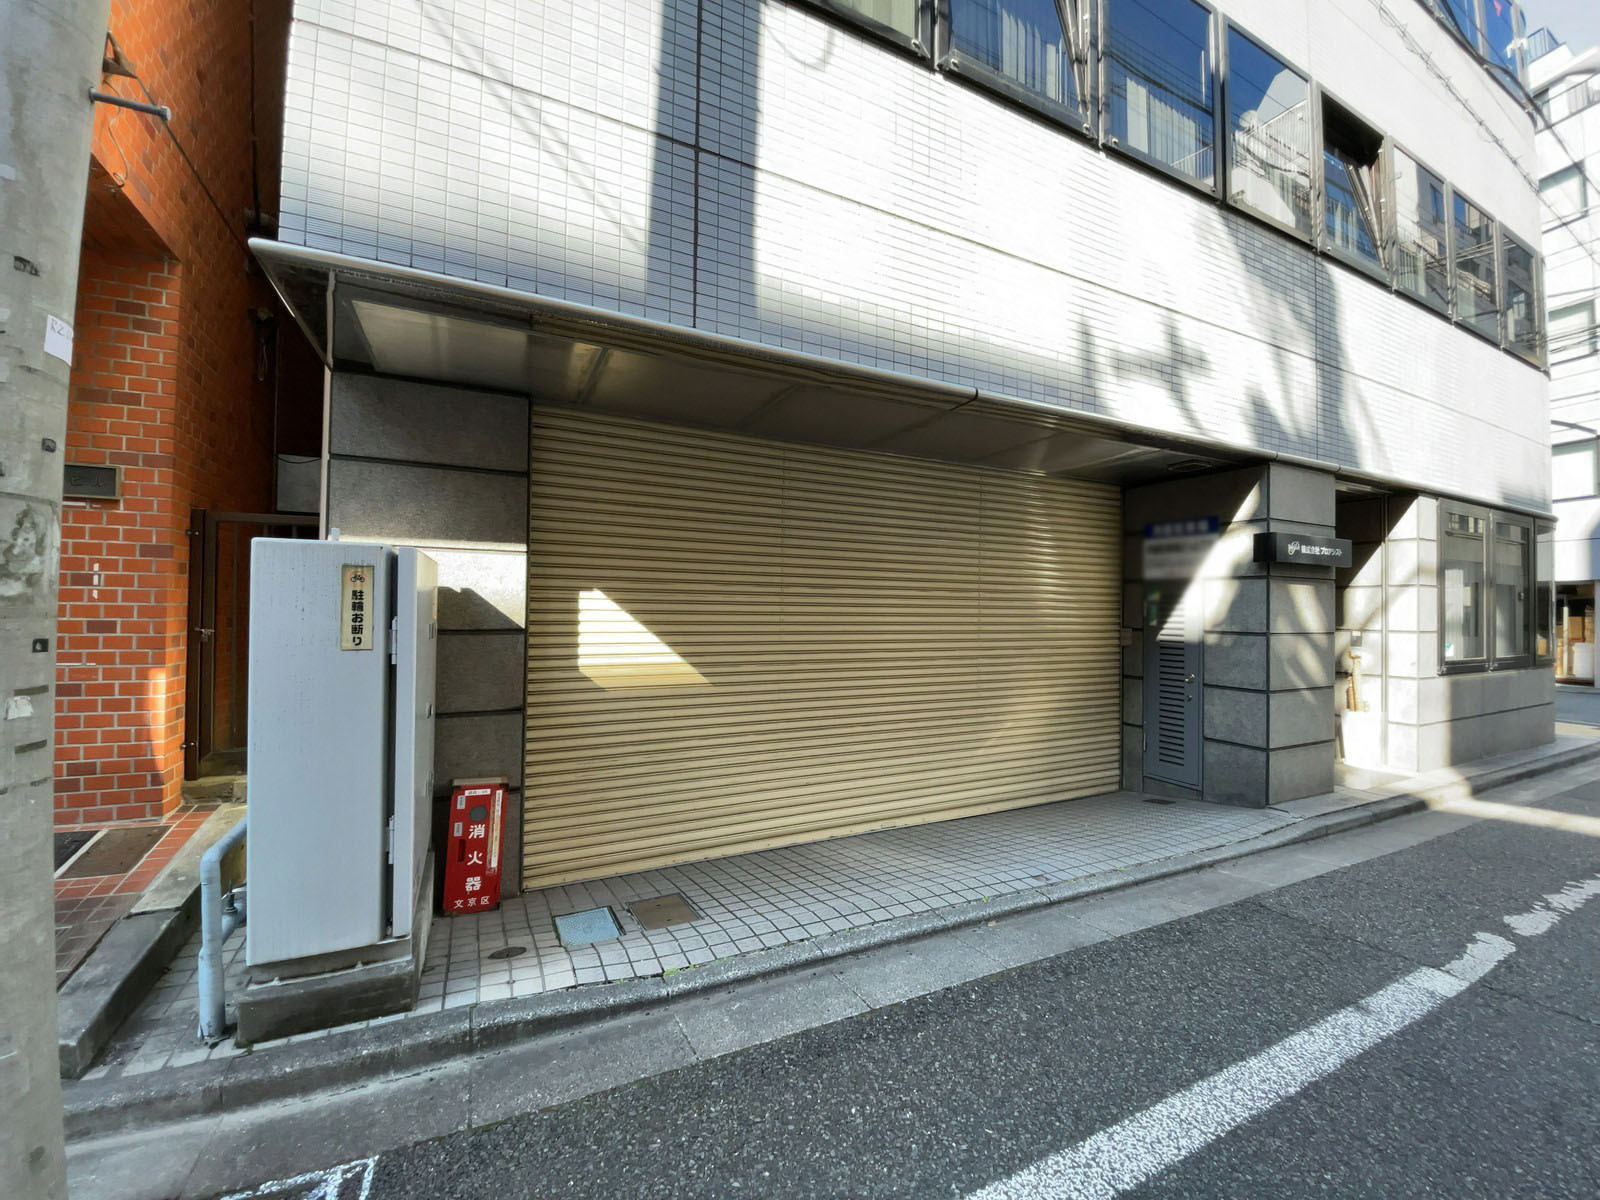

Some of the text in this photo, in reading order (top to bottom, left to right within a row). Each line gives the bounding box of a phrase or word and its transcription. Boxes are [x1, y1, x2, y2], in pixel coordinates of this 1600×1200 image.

[351, 589, 364, 647] 駐輪お断り
[465, 823, 486, 892] 消火器
[453, 895, 490, 909] 文京区
